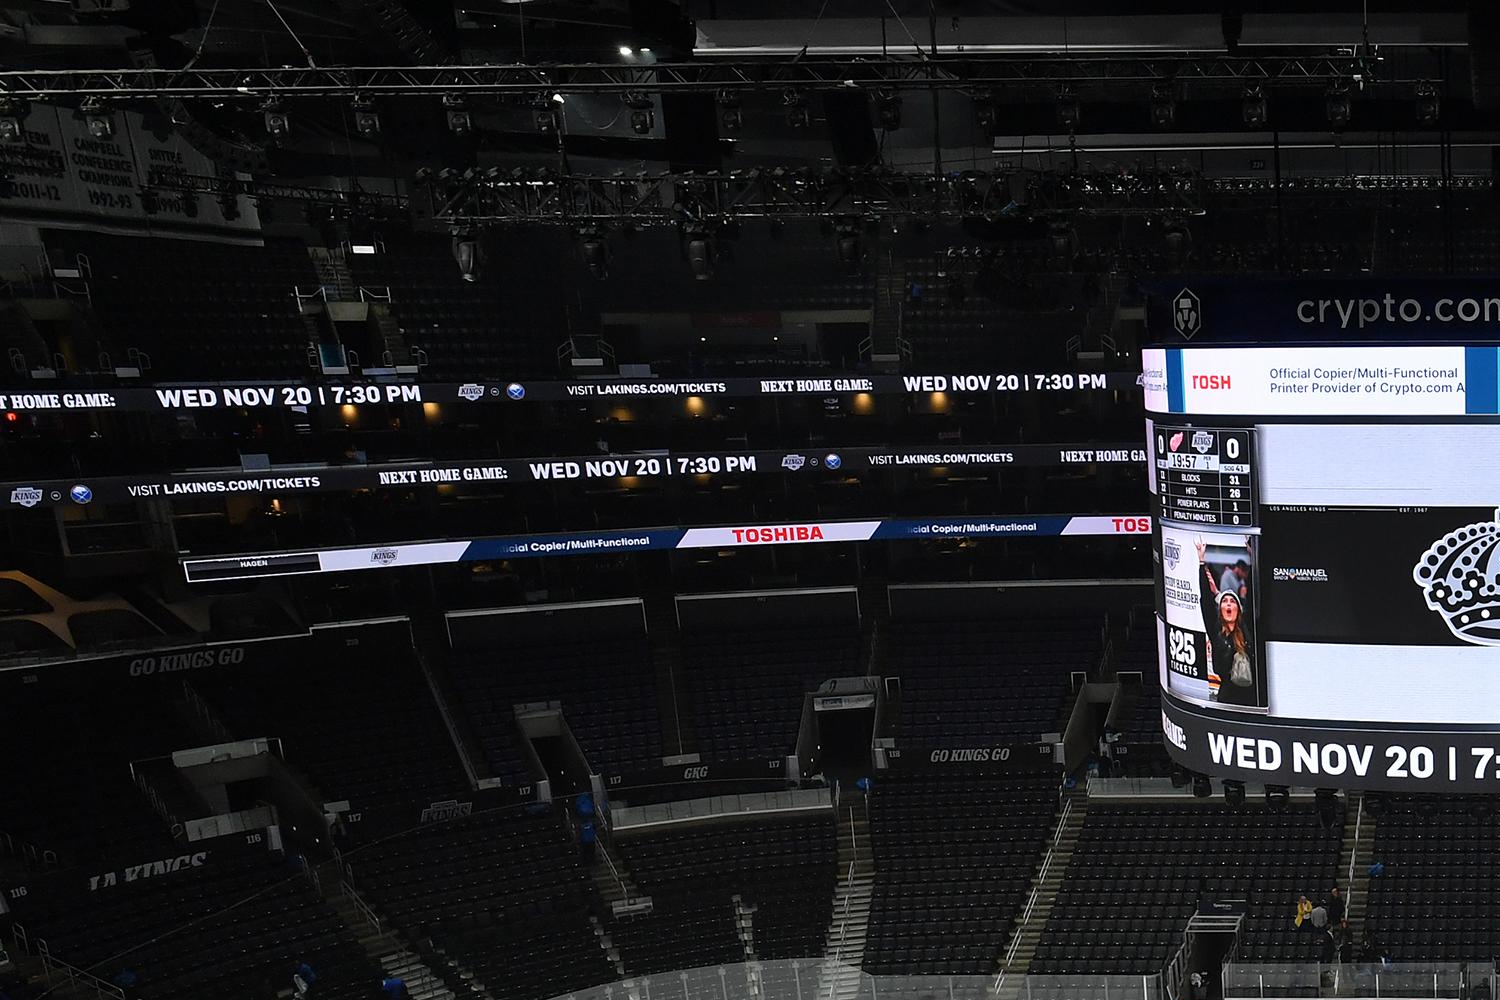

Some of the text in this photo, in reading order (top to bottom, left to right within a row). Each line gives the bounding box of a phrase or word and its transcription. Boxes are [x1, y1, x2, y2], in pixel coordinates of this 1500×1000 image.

[72, 152, 133, 172] CONFERENCE
[1270, 368, 1458, 380] Official Copier/Multi-Functional
[155, 385, 421, 408] WED NOV 20 7:30 PM
[567, 383, 725, 396] VISIT LAKINGS.COM/TICKETS
[1270, 382, 1452, 395] Printer Provider of Crypto.com
[12, 393, 116, 409] HOME GAME:
[1227, 438, 1239, 458] 0
[128, 477, 320, 497] VISIT LAKINGS.COM/TICKETS
[1229, 475, 1240, 485] 31
[732, 526, 822, 543] TOSHIBA
[531, 536, 649, 552] Copier/Multi-Functional
[240, 560, 267, 568] HAGEN
[1273, 568, 1328, 577] SAN MANUEL
[1169, 627, 1196, 666] $25
[129, 648, 245, 678] GO KINGS GO
[1170, 659, 1198, 677] TICKETS
[930, 749, 1010, 762] GO KINGS GO
[1208, 732, 1282, 771] WED
[1293, 741, 1374, 776] NOV
[1385, 746, 1434, 779] 20
[683, 765, 708, 780] GKG
